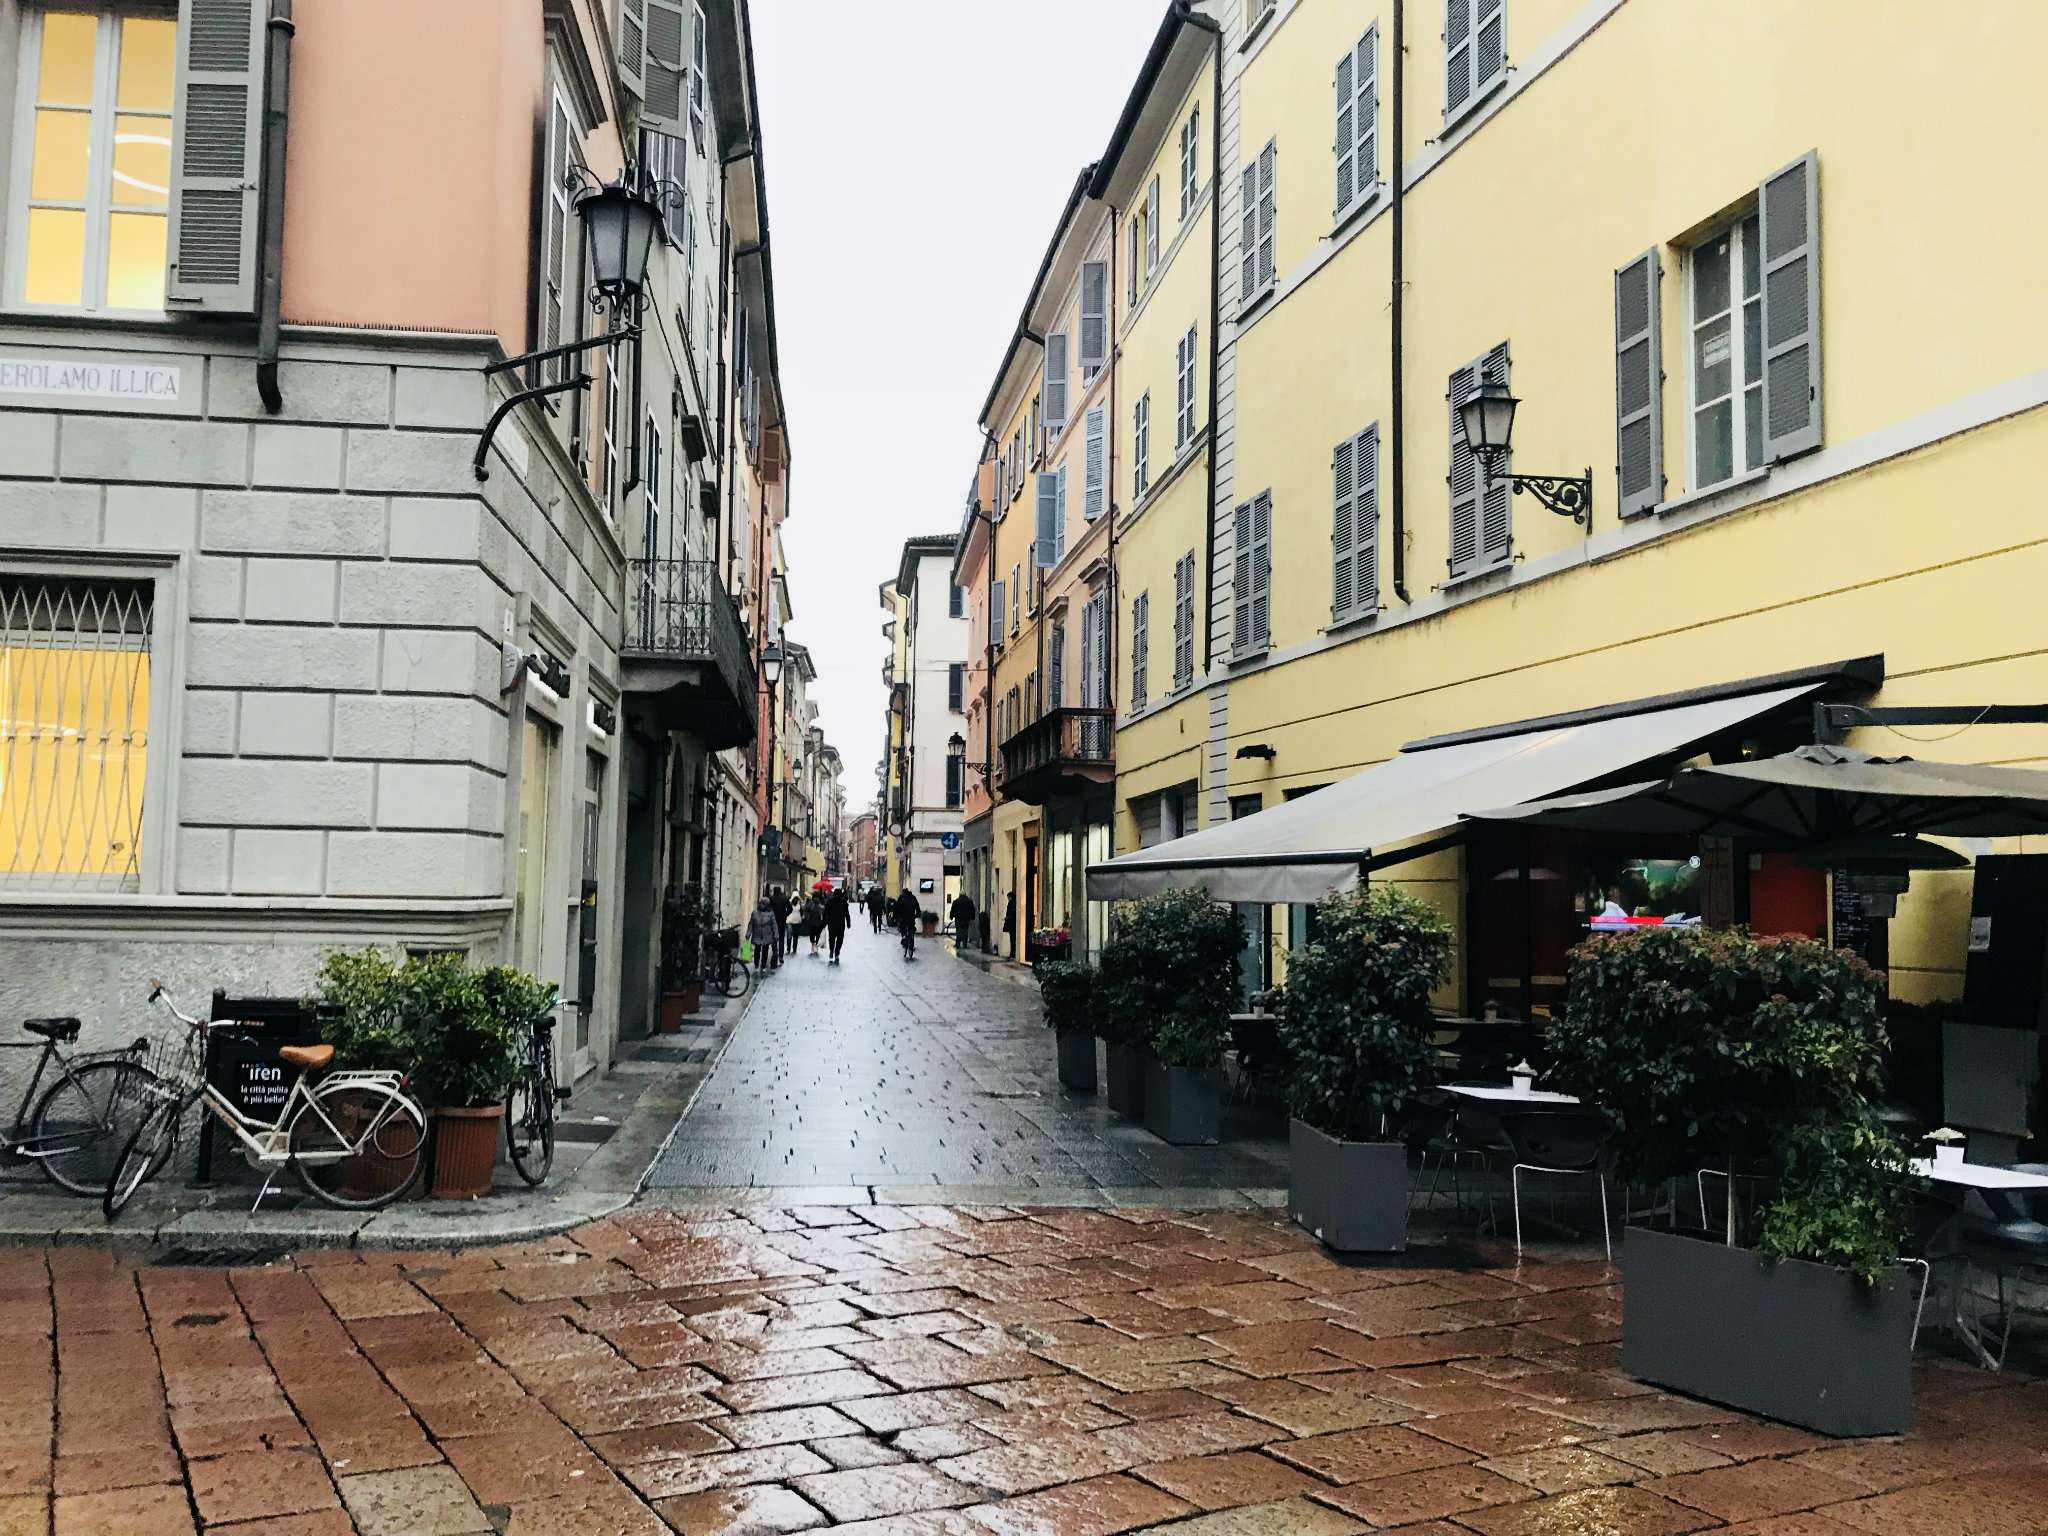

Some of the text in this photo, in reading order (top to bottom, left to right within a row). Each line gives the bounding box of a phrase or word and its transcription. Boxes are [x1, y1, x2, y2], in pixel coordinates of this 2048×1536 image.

[111, 369, 177, 395] ILLICA
[249, 1085, 266, 1094] città
[267, 1085, 289, 1095] pulita
[250, 1095, 263, 1105] più
